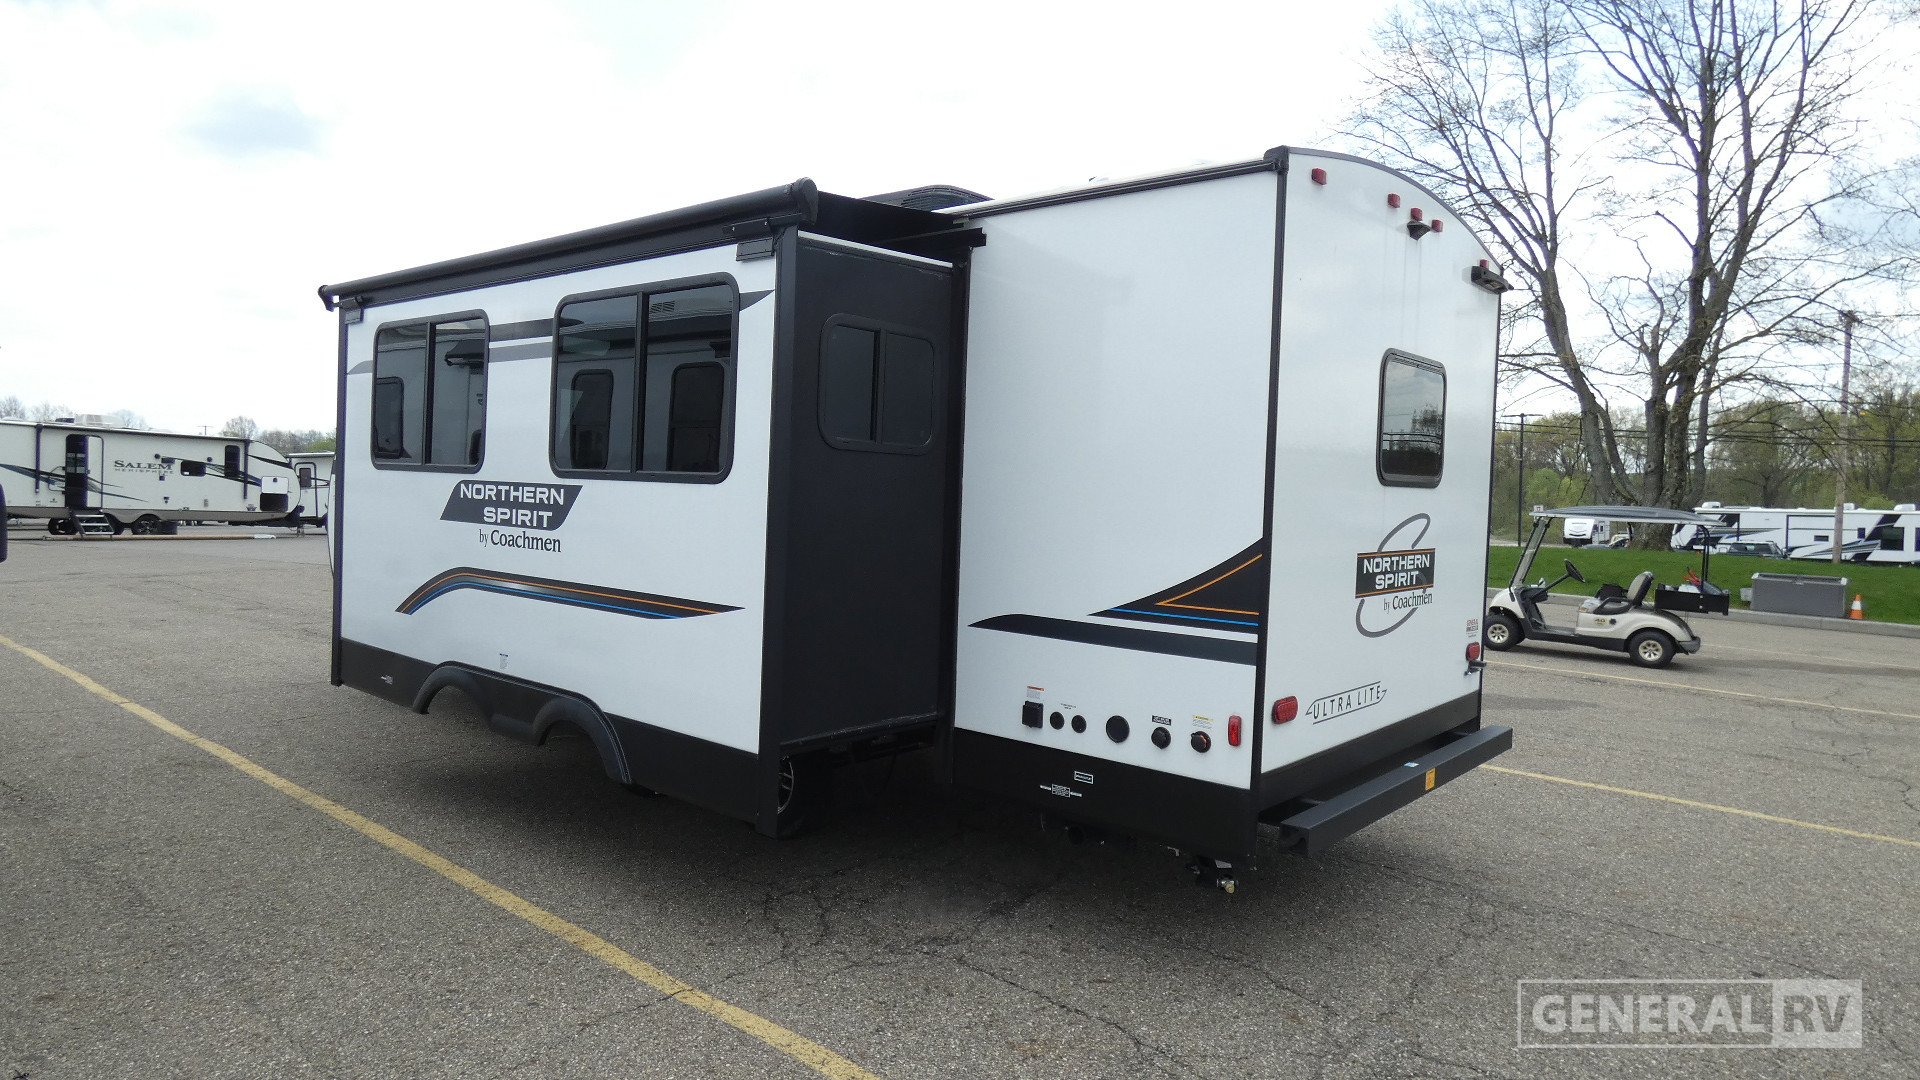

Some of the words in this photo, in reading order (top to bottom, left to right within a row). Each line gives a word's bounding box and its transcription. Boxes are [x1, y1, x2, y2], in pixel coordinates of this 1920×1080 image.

[114, 460, 173, 470] SALEM
[460, 483, 564, 506] NORTHERN
[483, 507, 553, 528] SPIRIT
[479, 529, 488, 547] by
[490, 529, 562, 553] Coachmen
[1363, 554, 1430, 574] NORTHERN
[1375, 571, 1419, 590] SPIRIT
[1383, 598, 1391, 614] by
[1392, 592, 1433, 610] Coachmen
[1313, 695, 1352, 719] ULTRA
[1357, 685, 1381, 706] LITE
